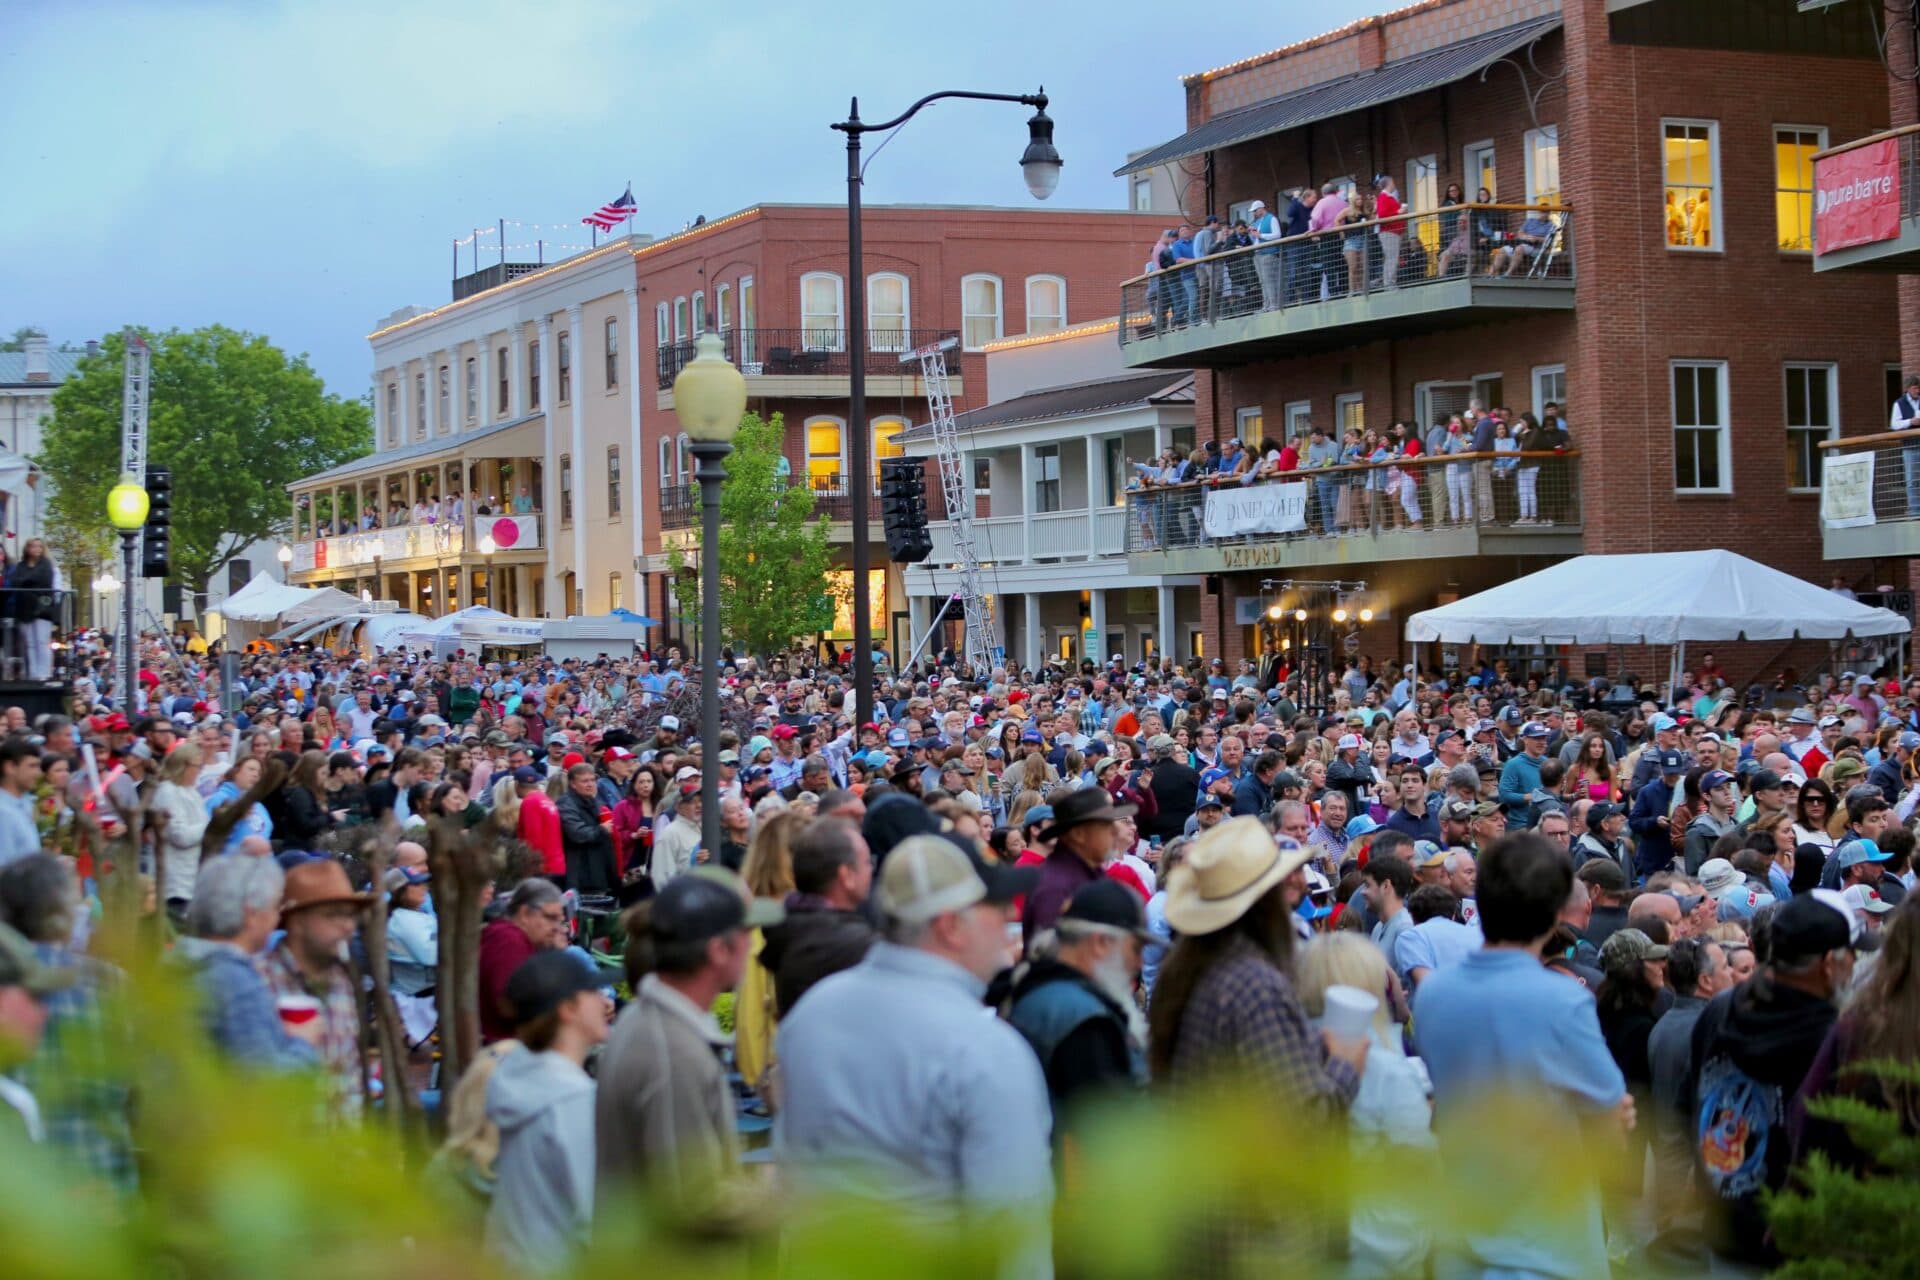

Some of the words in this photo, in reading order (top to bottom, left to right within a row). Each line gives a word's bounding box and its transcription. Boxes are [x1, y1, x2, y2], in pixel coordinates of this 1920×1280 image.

[1826, 185, 1853, 213] pure
[1855, 175, 1892, 200] barre
[1224, 547, 1281, 567] OXFORD
